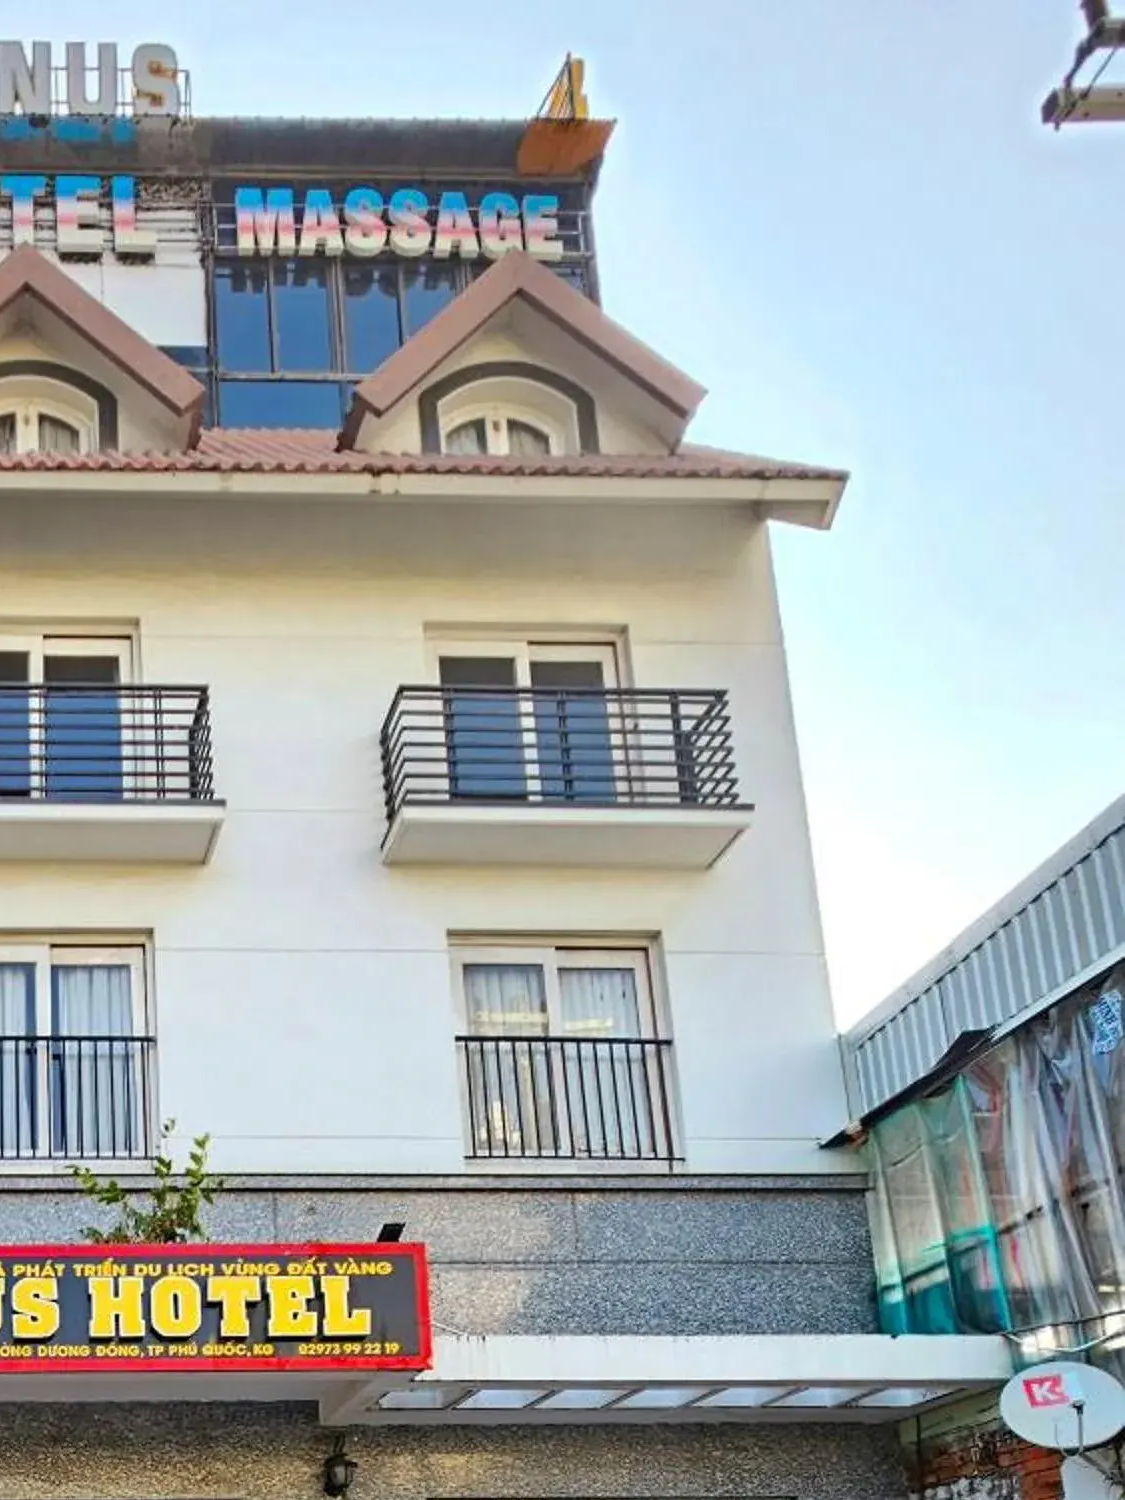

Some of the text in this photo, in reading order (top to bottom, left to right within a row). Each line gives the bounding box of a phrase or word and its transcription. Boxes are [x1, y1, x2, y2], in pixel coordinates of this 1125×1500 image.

[235, 186, 564, 261] MASSAGE
[12, 1259, 66, 1277] PHÁT
[134, 1263, 162, 1277] DU
[334, 1257, 393, 1275] VÀNG
[87, 1275, 373, 1339] HOTEL
[146, 1345, 164, 1357] TP
[168, 1341, 198, 1357] PHÚ
[384, 1341, 400, 1354] 19
